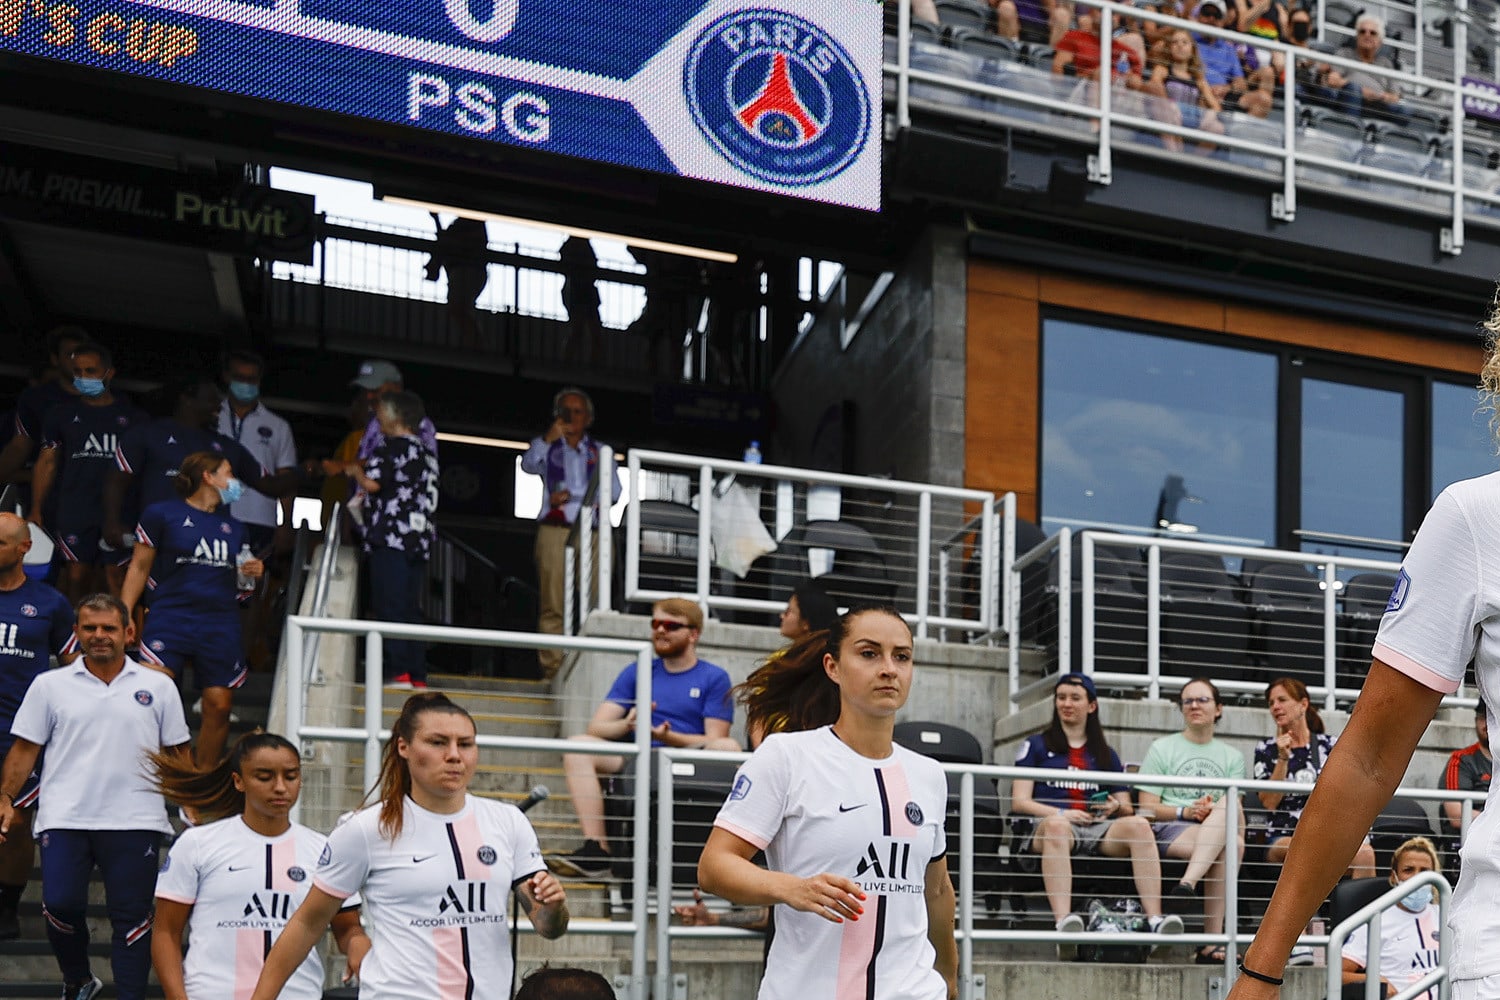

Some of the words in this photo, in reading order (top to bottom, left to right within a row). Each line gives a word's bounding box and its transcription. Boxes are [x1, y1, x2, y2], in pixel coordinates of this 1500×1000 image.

[86, 11, 198, 67] CUP
[720, 20, 838, 75] PARIS
[406, 69, 551, 143] PSG
[174, 191, 288, 238] Prüvit
[864, 883, 887, 892] LIVE
[217, 920, 248, 929] ACCOR
[250, 920, 271, 928] LIVE
[409, 918, 442, 928] ACCOR
[444, 916, 467, 926] LIVE
